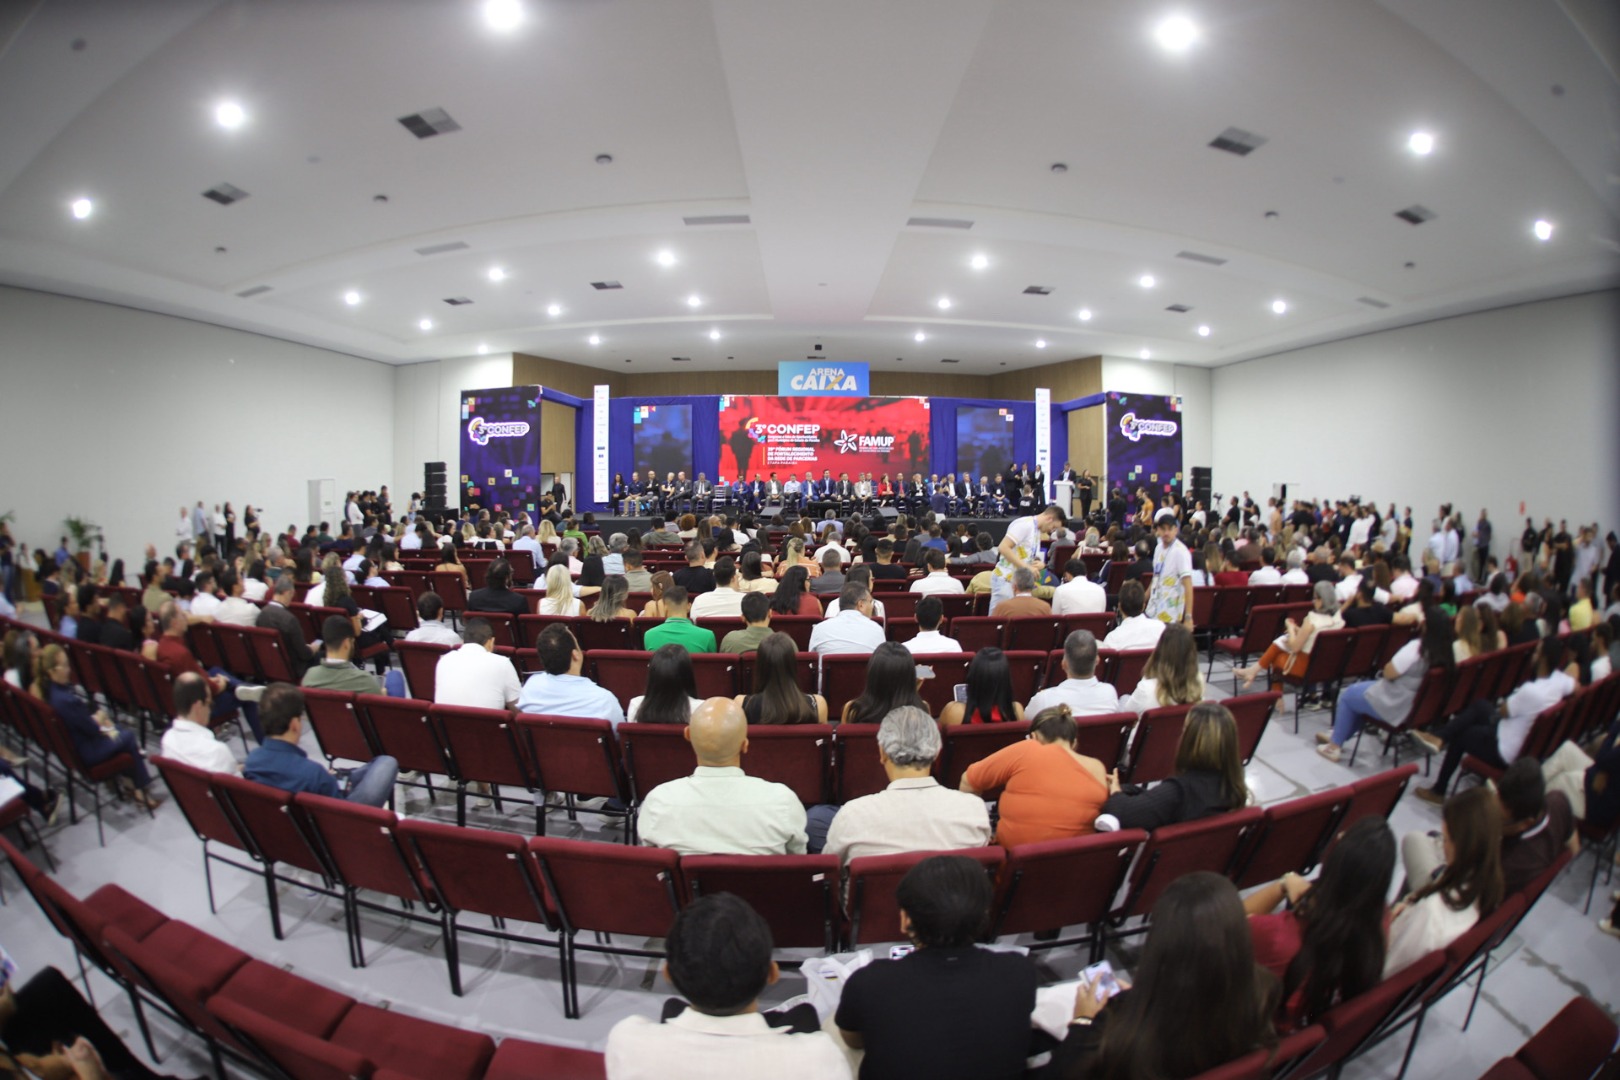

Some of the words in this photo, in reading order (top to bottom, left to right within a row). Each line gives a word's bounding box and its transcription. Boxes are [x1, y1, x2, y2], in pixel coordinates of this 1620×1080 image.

[809, 368, 845, 376] ARENA
[790, 374, 858, 391] CAIXA
[487, 425, 527, 435] CONFEP
[767, 424, 821, 435] CONFEP
[1138, 421, 1175, 432] CONFEP
[859, 436, 895, 447] FAMUP
